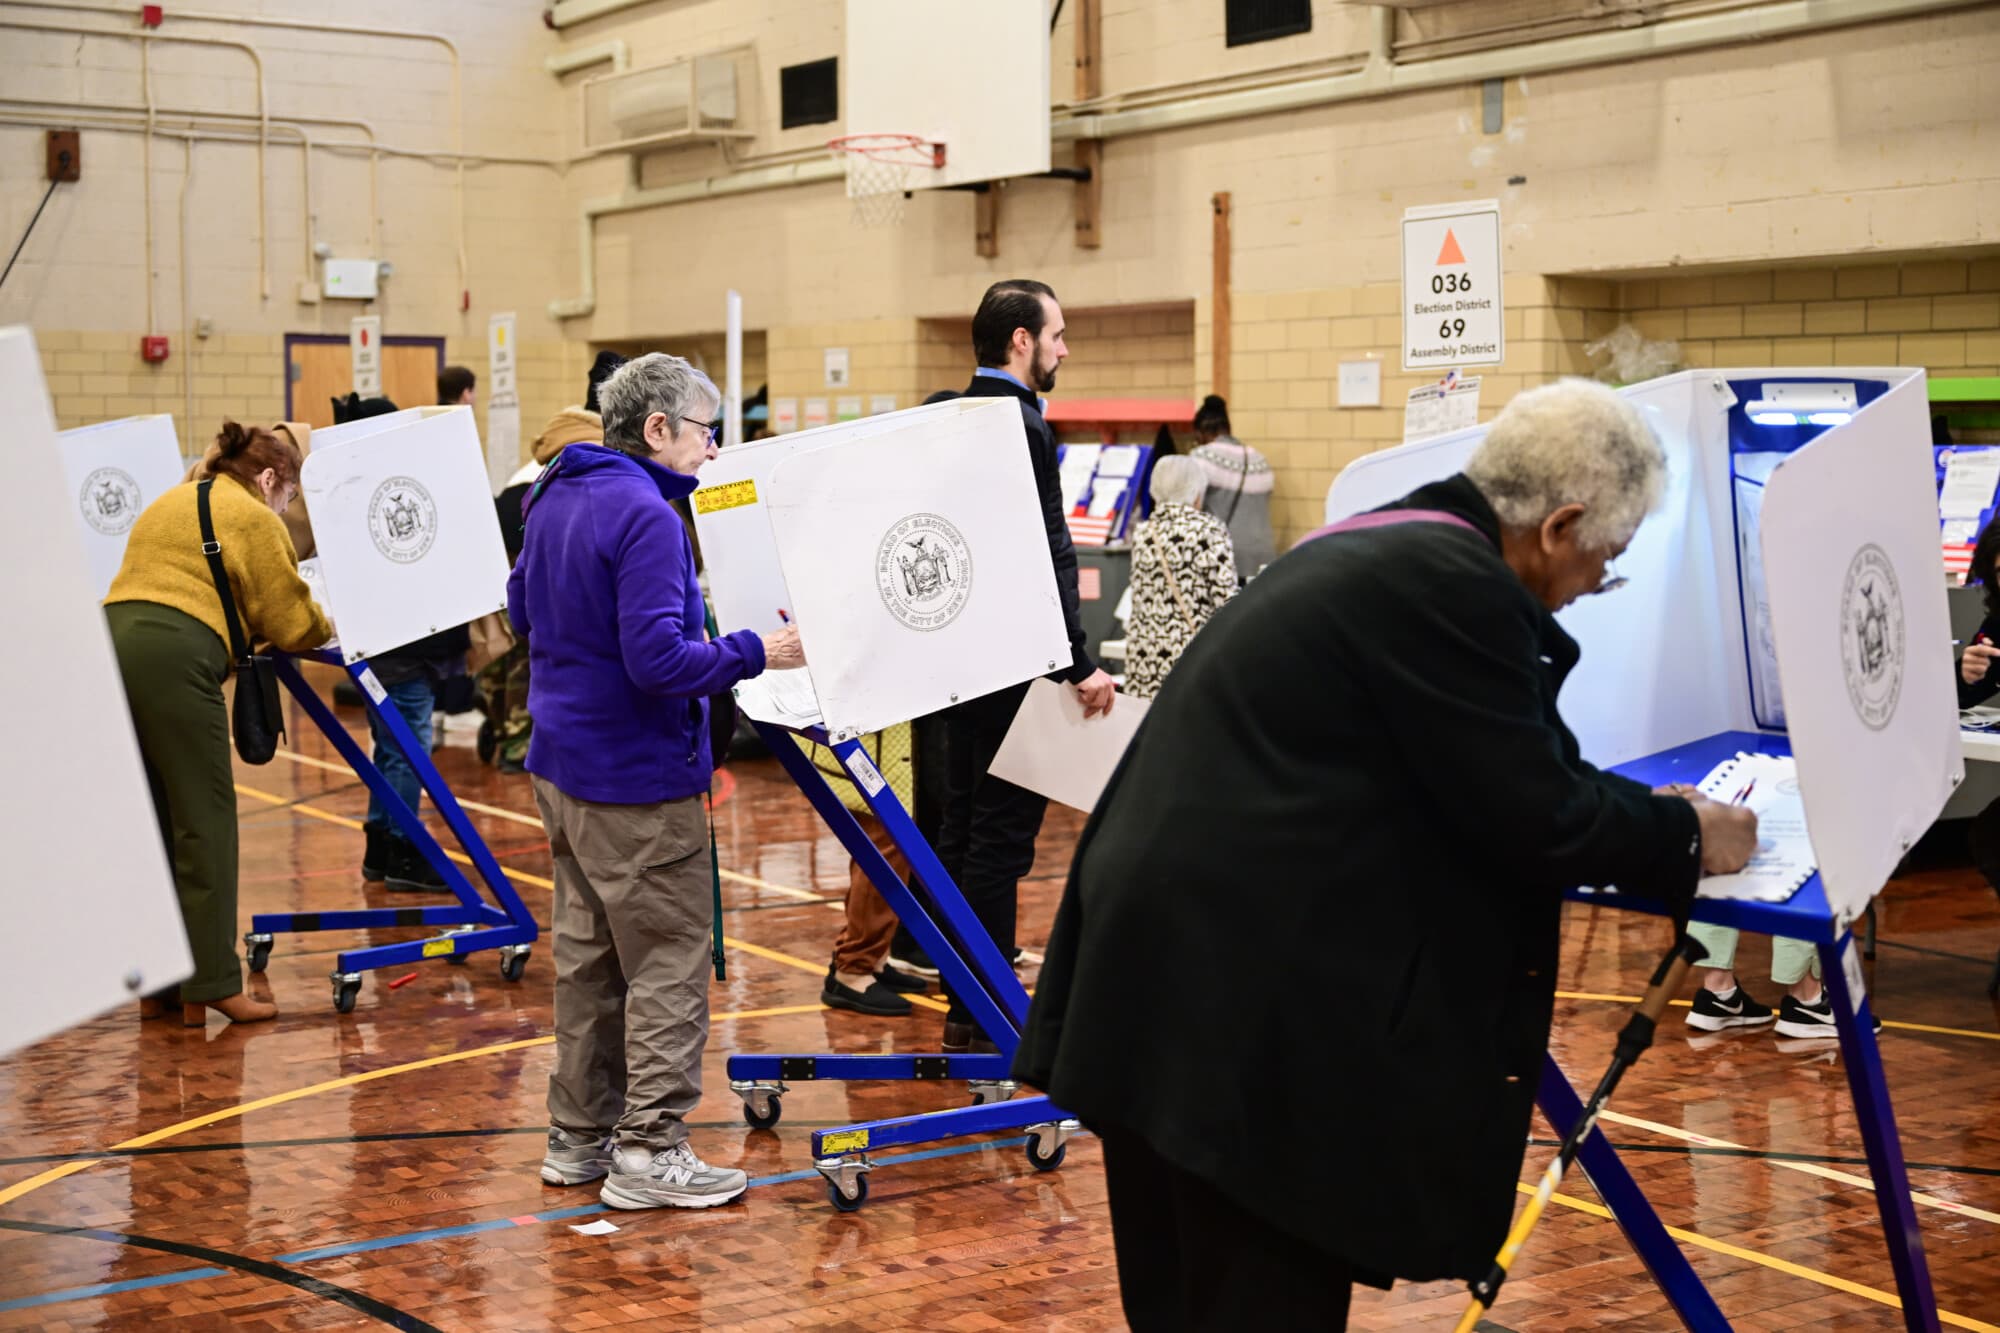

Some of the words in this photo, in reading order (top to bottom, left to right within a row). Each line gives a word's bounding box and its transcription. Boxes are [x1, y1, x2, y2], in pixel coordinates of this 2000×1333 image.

[1432, 272, 1472, 294] 036
[1414, 303, 1453, 315] Election
[1456, 298, 1491, 311] District
[1439, 318, 1466, 339] 69
[1410, 345, 1457, 359] Assembly
[1460, 343, 1496, 355] District
[705, 479, 753, 493] CAUTION
[909, 615, 932, 626] CITY
[934, 611, 946, 624] OF
[661, 1165, 694, 1187] N
